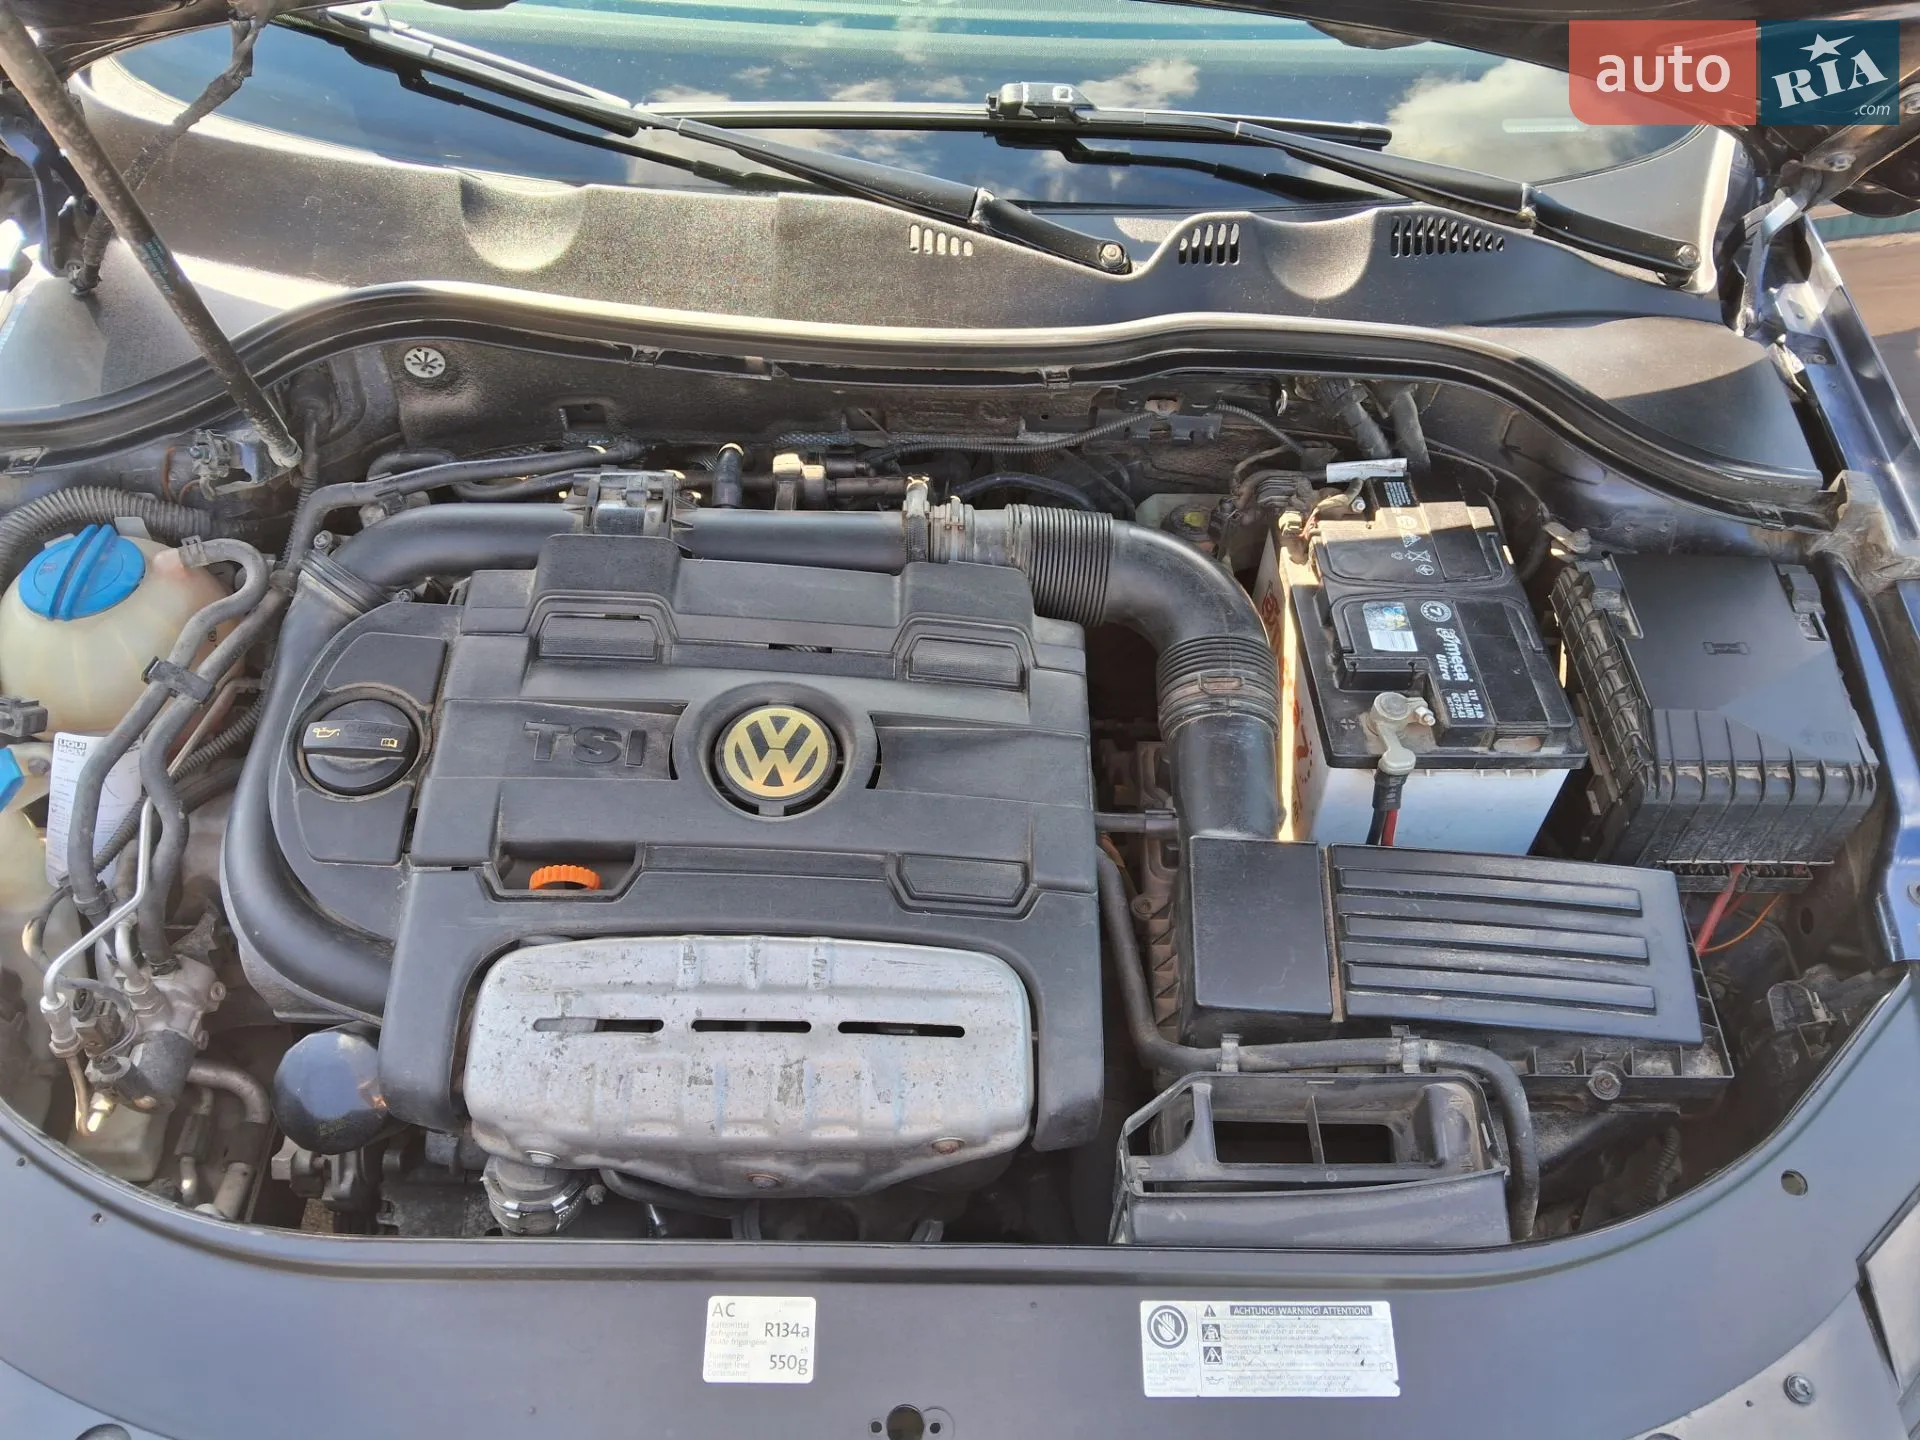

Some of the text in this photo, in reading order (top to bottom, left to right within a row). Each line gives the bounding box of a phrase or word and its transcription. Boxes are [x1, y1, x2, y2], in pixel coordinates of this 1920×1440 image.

[1436, 653, 1451, 680] Ultra
[523, 719, 648, 768] TSI
[712, 1302, 736, 1318] AC
[1233, 1305, 1371, 1316] ACHTUNG! WARNING! ATTENTION!
[764, 1322, 810, 1338] R134a
[769, 1354, 808, 1375] 550g
